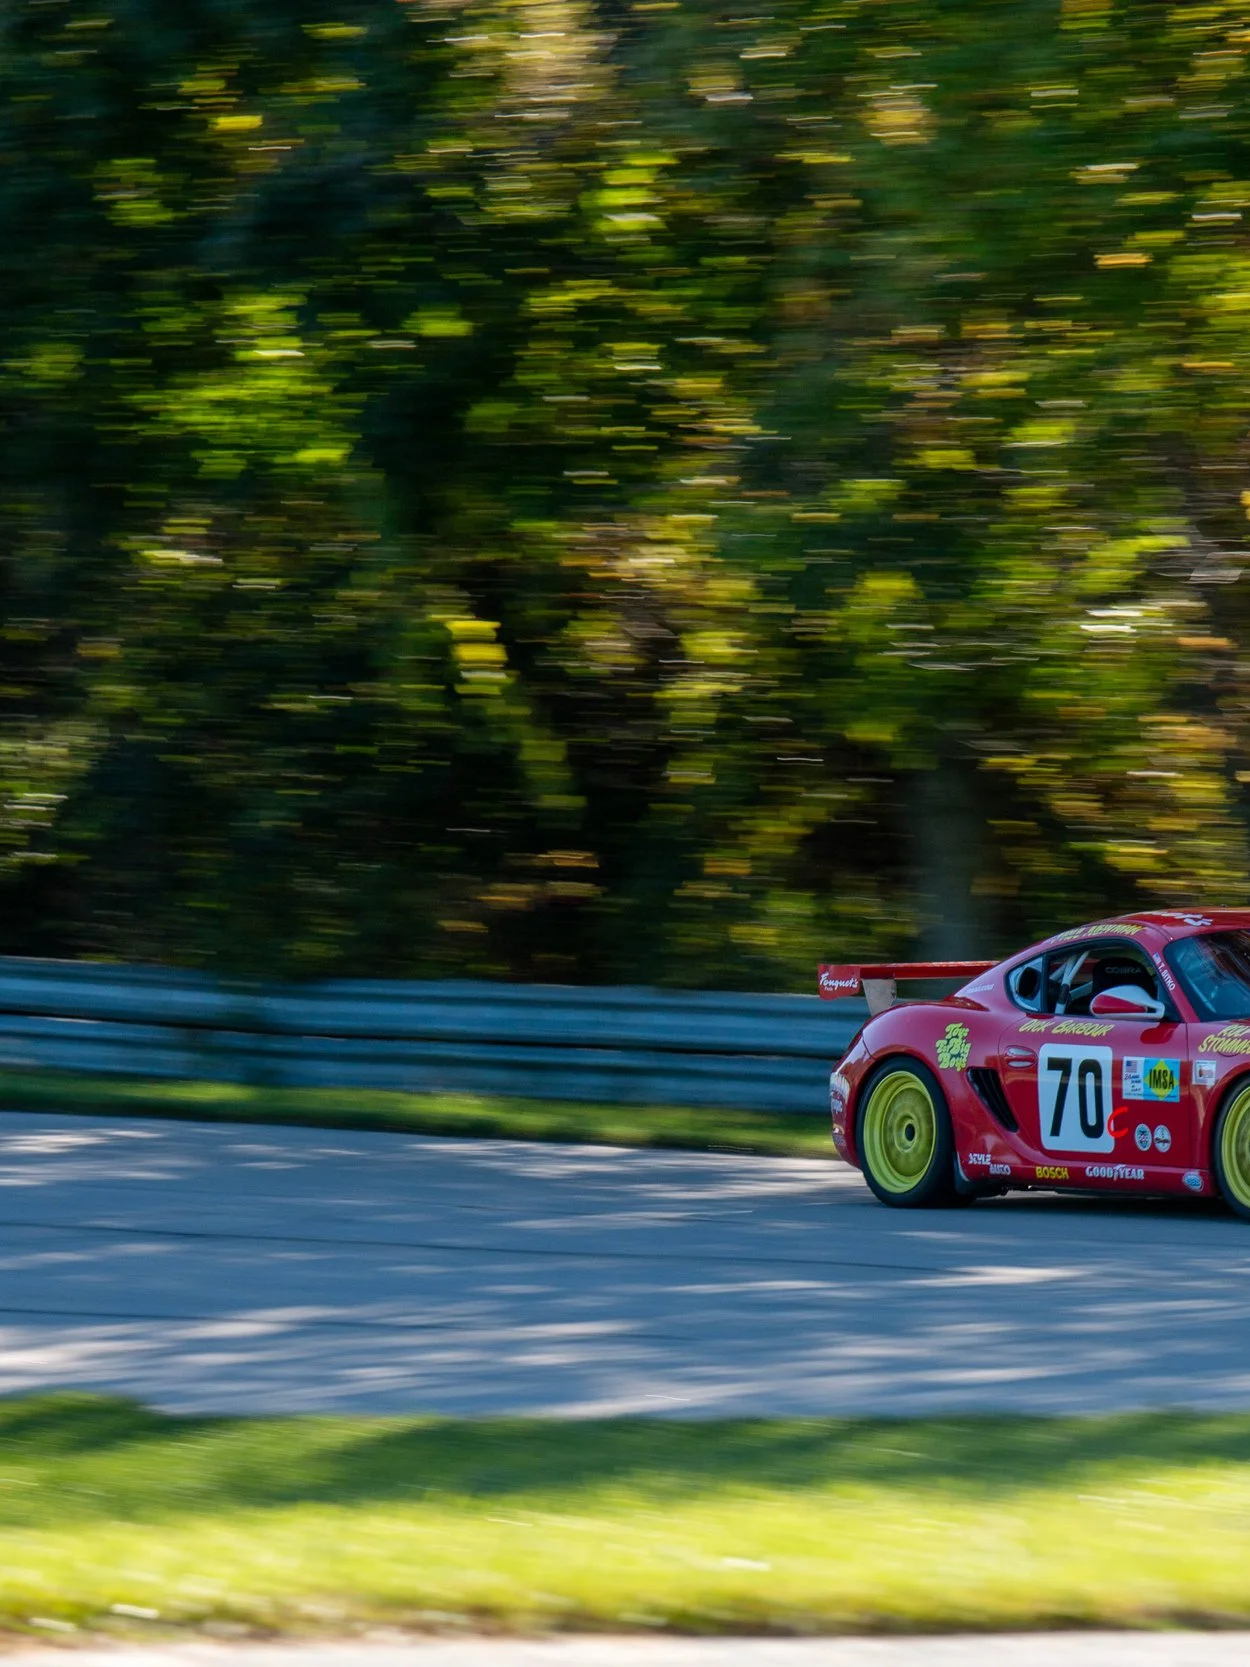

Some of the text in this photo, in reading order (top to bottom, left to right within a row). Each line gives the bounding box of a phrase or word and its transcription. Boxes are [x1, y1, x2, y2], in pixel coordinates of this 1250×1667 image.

[1018, 1019, 1116, 1037] DICK BARBOUR
[1149, 1069, 1175, 1089] IMSA
[1047, 1057, 1104, 1139] 70
[1107, 1106, 1129, 1139] C
[1035, 1166, 1069, 1180] BOSCH
[1085, 1164, 1145, 1181] GOODYEAR
